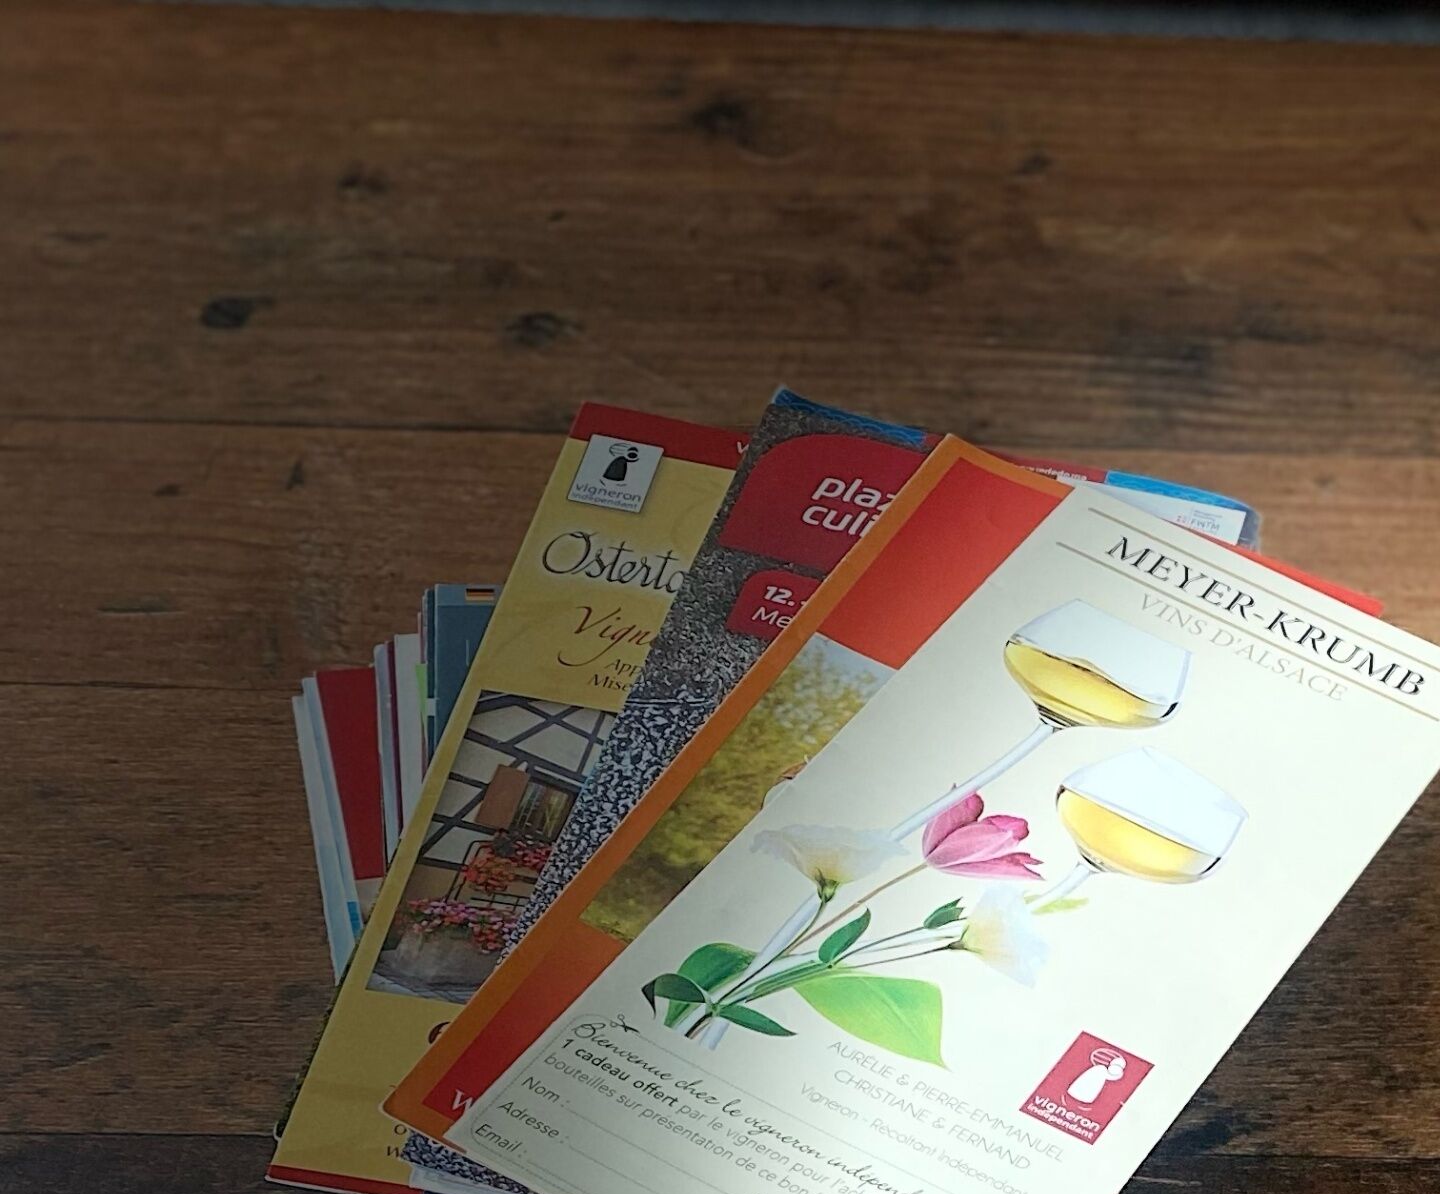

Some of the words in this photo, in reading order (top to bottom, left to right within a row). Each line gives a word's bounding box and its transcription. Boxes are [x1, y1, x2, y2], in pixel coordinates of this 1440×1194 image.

[1104, 535, 1427, 698] MEYER-KRUMB
[1139, 592, 1208, 638] VINS
[1211, 626, 1350, 703] D'ALSACE
[473, 1122, 521, 1154] Email
[496, 1100, 561, 1139] Adresse
[521, 1074, 561, 1105] Nom
[543, 1052, 617, 1098] bouteilles
[617, 1091, 642, 1111] sur
[638, 1105, 734, 1162] présentation
[734, 1154, 757, 1173] de
[757, 1166, 778, 1182] ce
[561, 1038, 573, 1050] 1
[574, 1047, 630, 1083] cadeau
[633, 1077, 681, 1109] offert
[678, 1103, 707, 1124] par
[706, 1113, 724, 1132] le
[725, 1127, 791, 1165] vigneron
[789, 1160, 827, 1185] pour
[572, 1022, 674, 1082] Bienvenue
[674, 1076, 722, 1107] chez
[722, 1097, 744, 1119] le
[744, 1114, 823, 1160] vigneron
[799, 1082, 861, 1123] Vigneron
[827, 1040, 893, 1079] AURÉLIE
[896, 1073, 910, 1087] &
[915, 1080, 1066, 1165] PIERRE-EMMANUEL
[833, 1068, 931, 1124] CHRISTIANE
[932, 1116, 945, 1130] &
[948, 1124, 1032, 1171] FERNAND
[1033, 1095, 1101, 1134] vigneron
